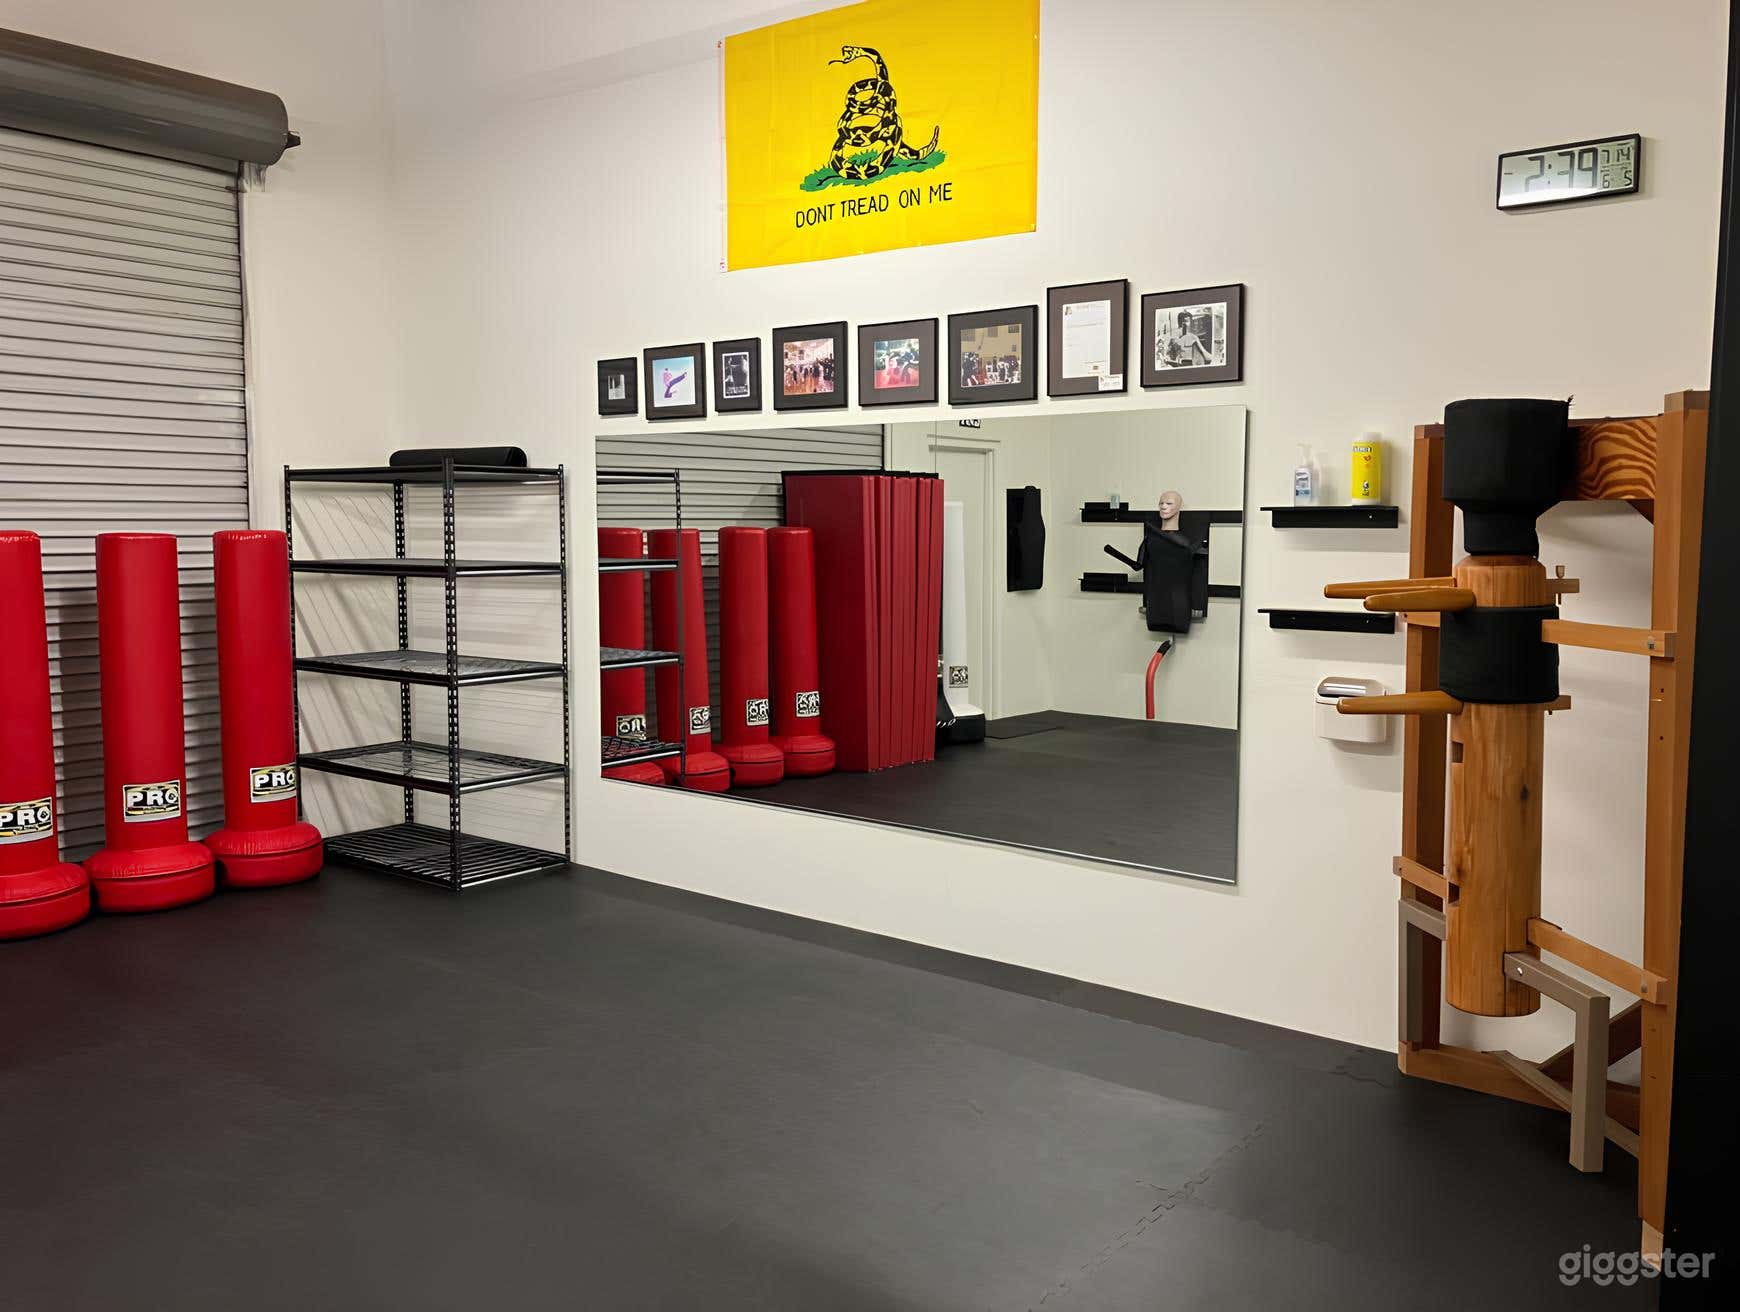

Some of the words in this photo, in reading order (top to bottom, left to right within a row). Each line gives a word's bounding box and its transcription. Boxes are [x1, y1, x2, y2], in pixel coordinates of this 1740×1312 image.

[795, 203, 836, 228] DONT
[840, 194, 889, 218] TREAD
[899, 187, 921, 209] ON
[929, 182, 953, 204] ME
[127, 788, 178, 808] PRO
[0, 805, 51, 828] PRO
